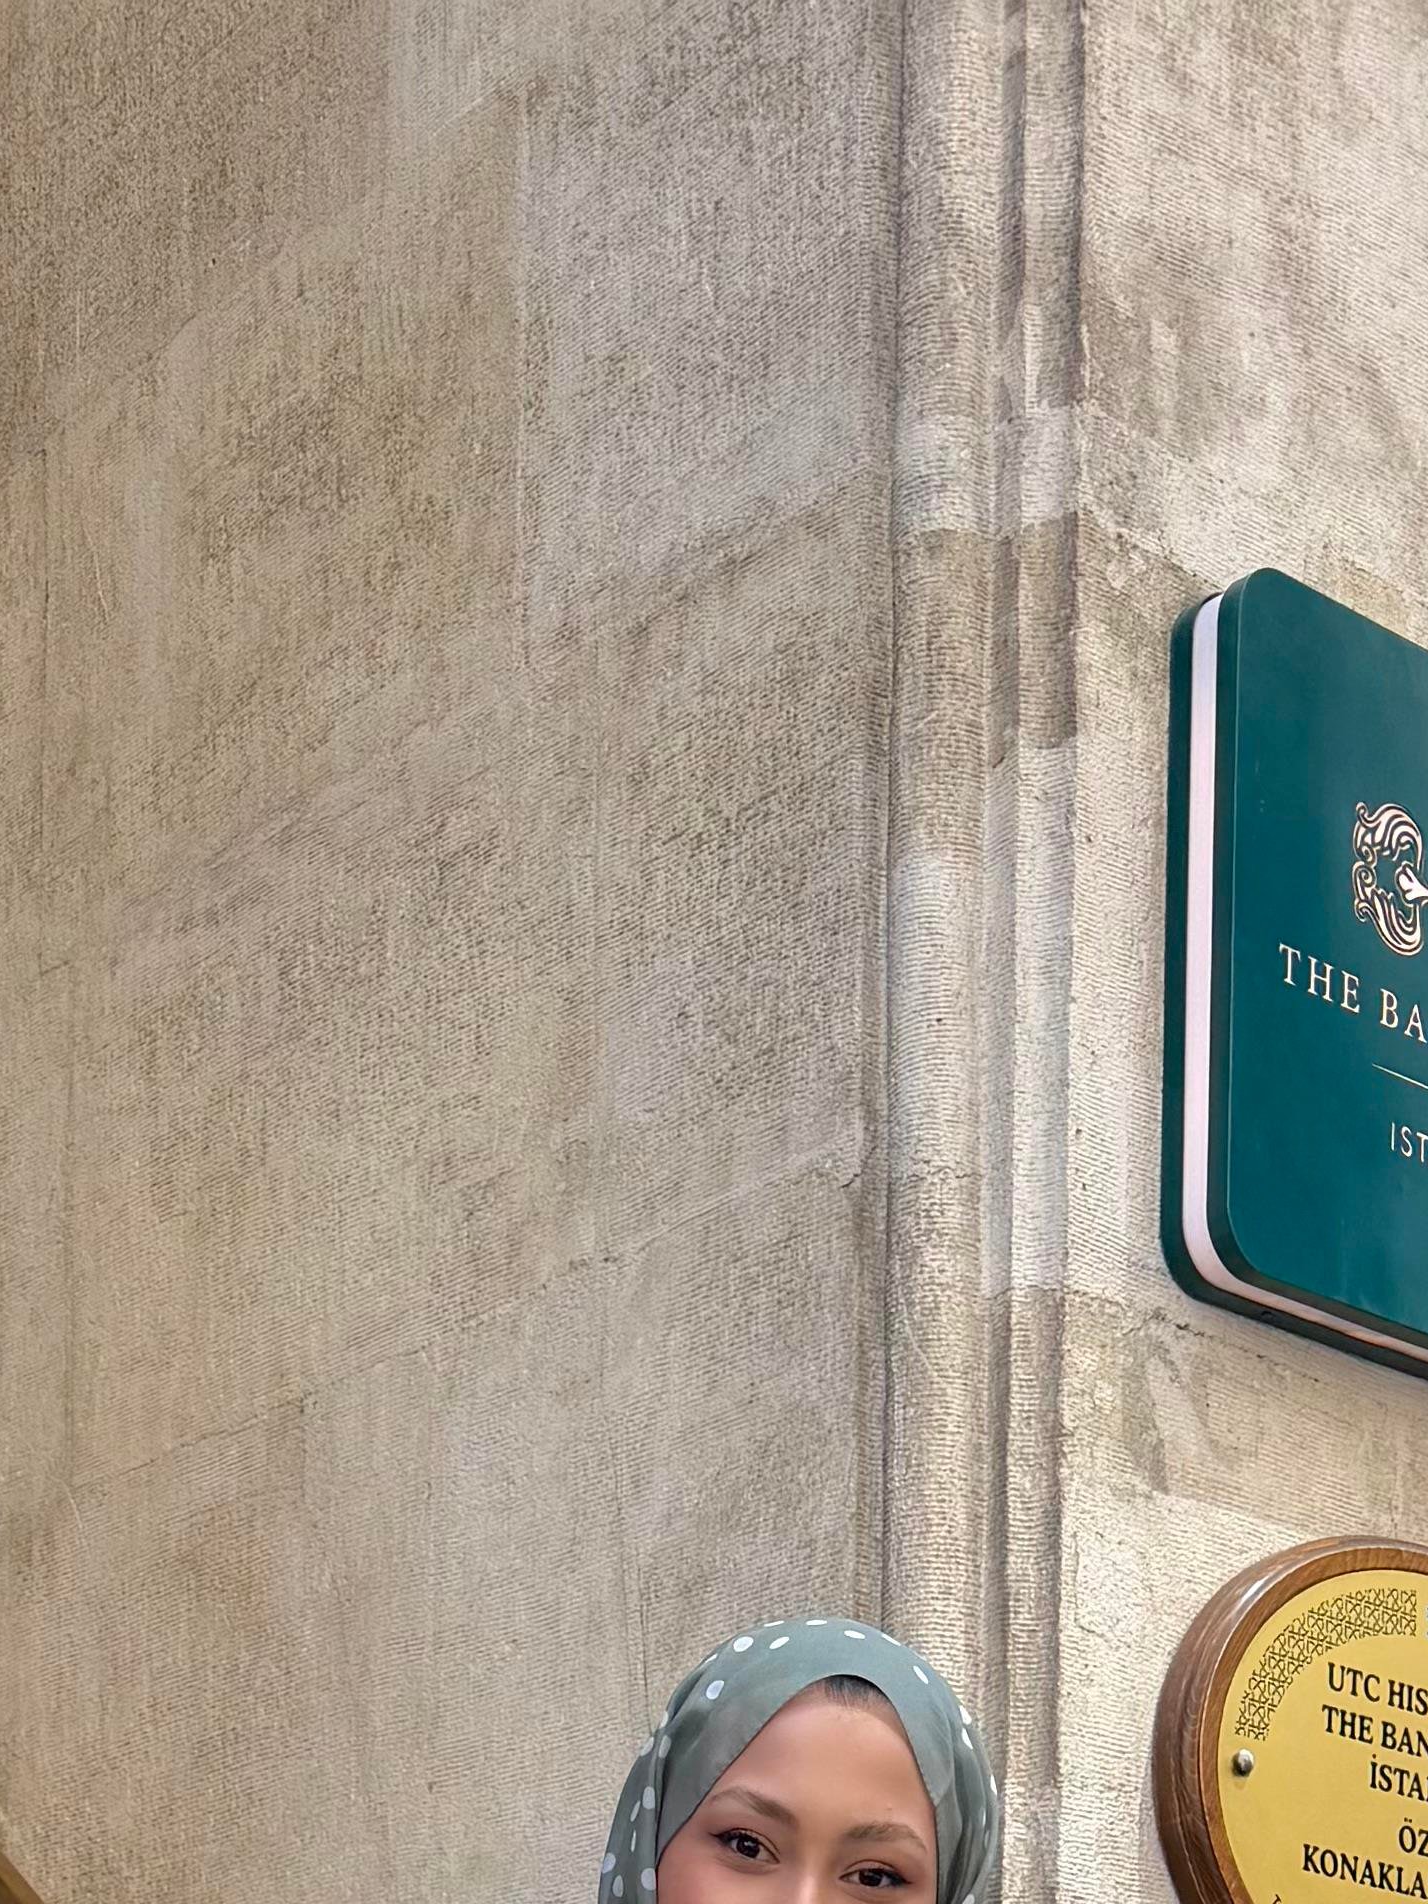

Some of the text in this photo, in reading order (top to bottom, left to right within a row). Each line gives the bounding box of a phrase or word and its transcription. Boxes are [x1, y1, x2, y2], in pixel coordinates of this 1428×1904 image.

[1279, 943, 1360, 1013] THE
[1327, 1662, 1380, 1703] UTC
[1322, 1704, 1373, 1745] THE
